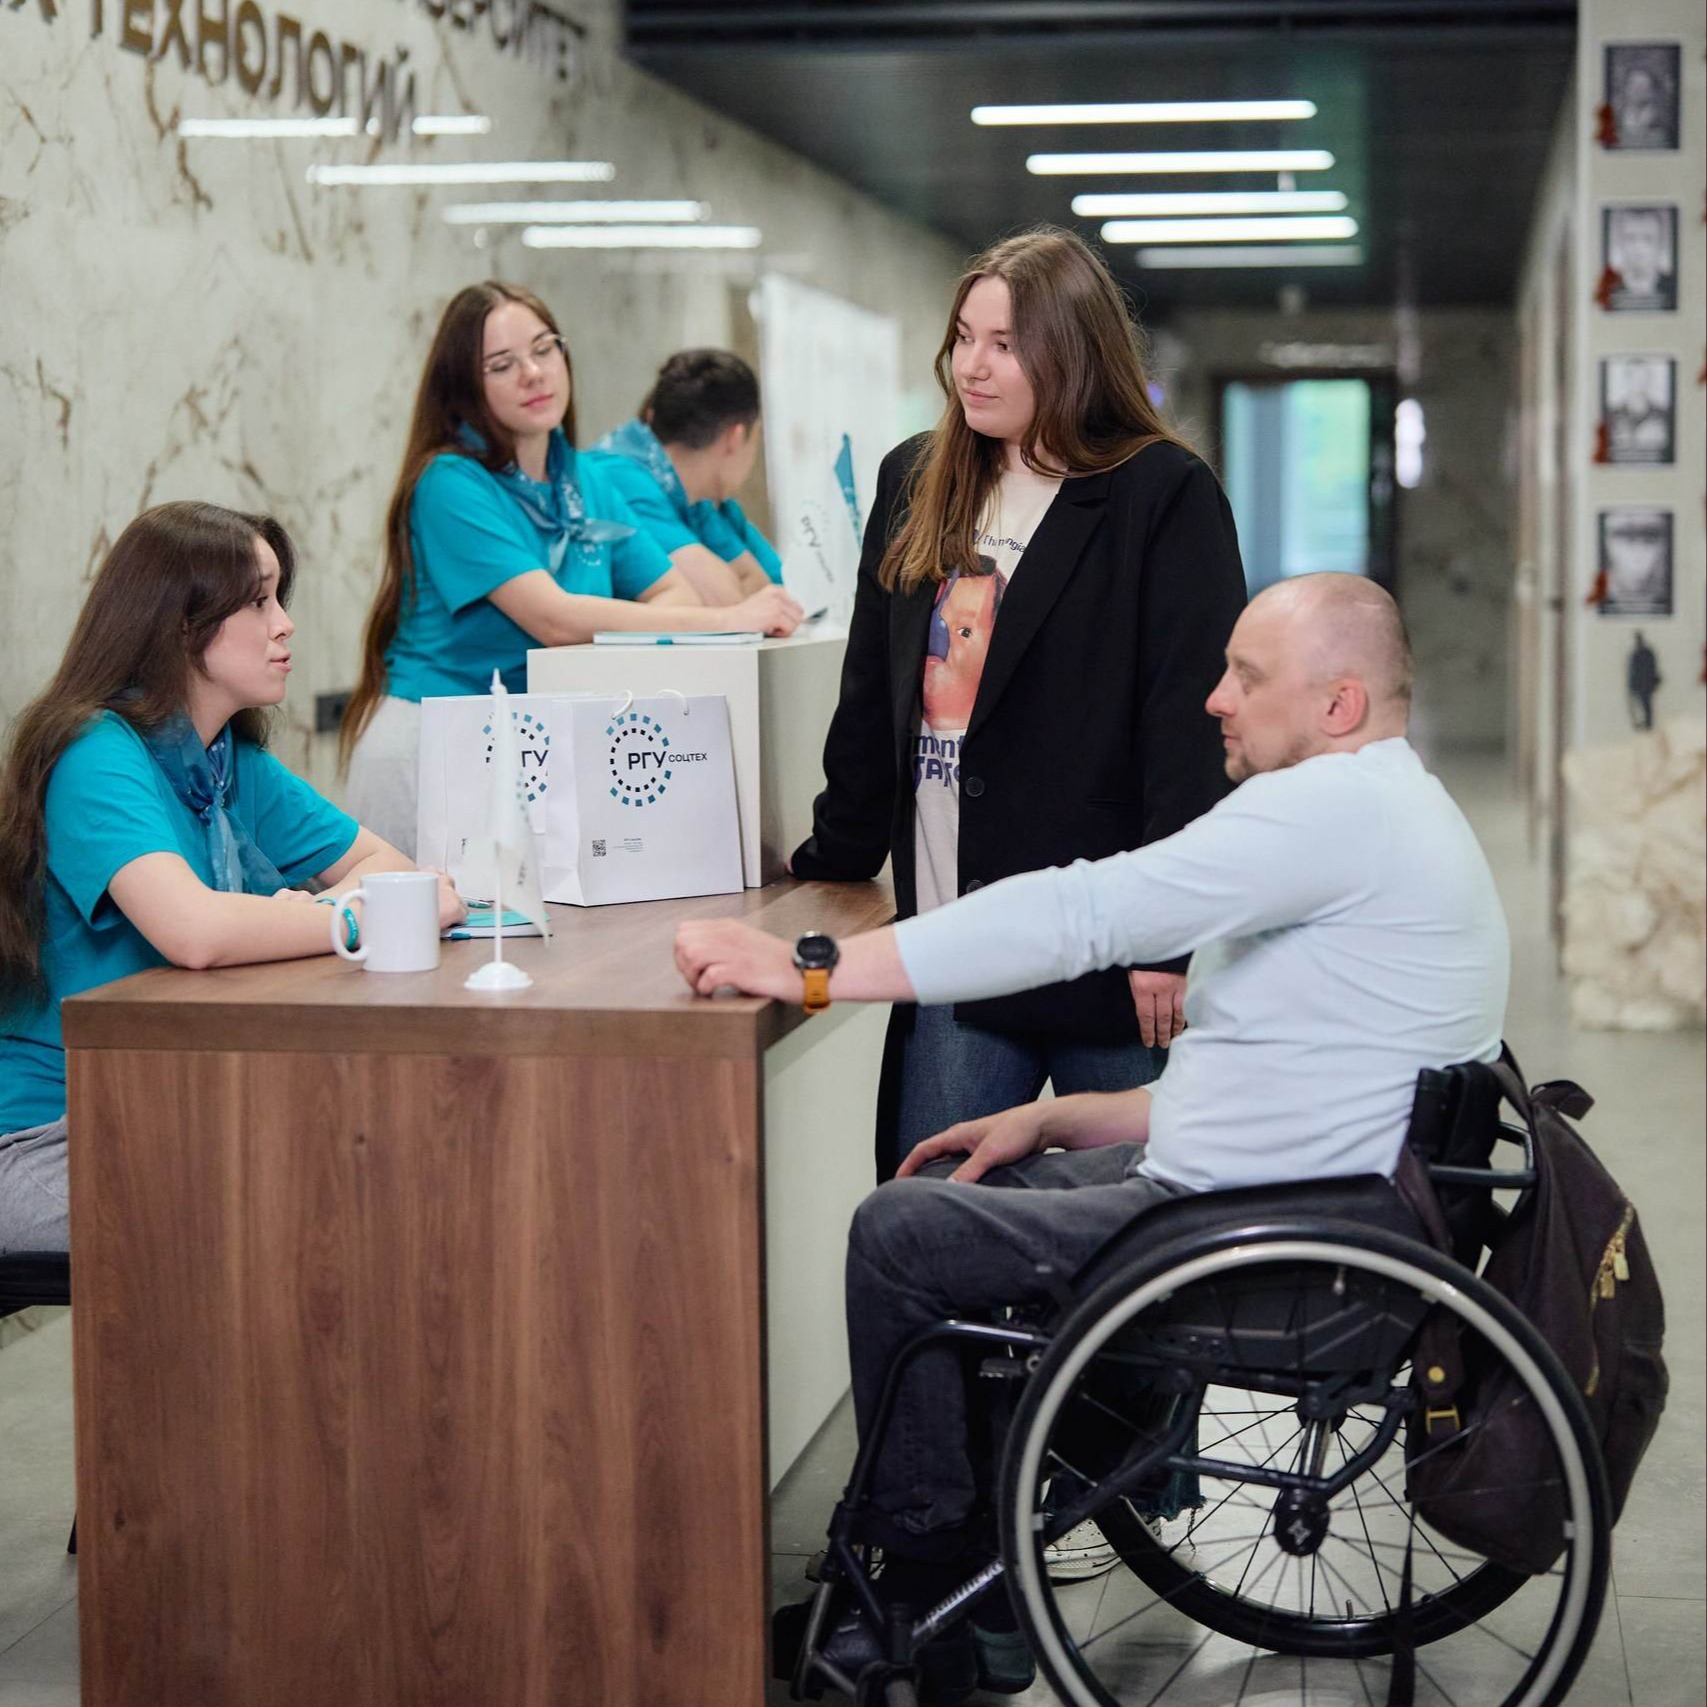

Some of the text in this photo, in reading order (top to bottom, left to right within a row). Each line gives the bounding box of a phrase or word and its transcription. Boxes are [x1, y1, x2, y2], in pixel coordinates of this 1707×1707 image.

[521, 749, 549, 767] ГУ
[628, 751, 708, 770] РГУ СОЦТЕХ
